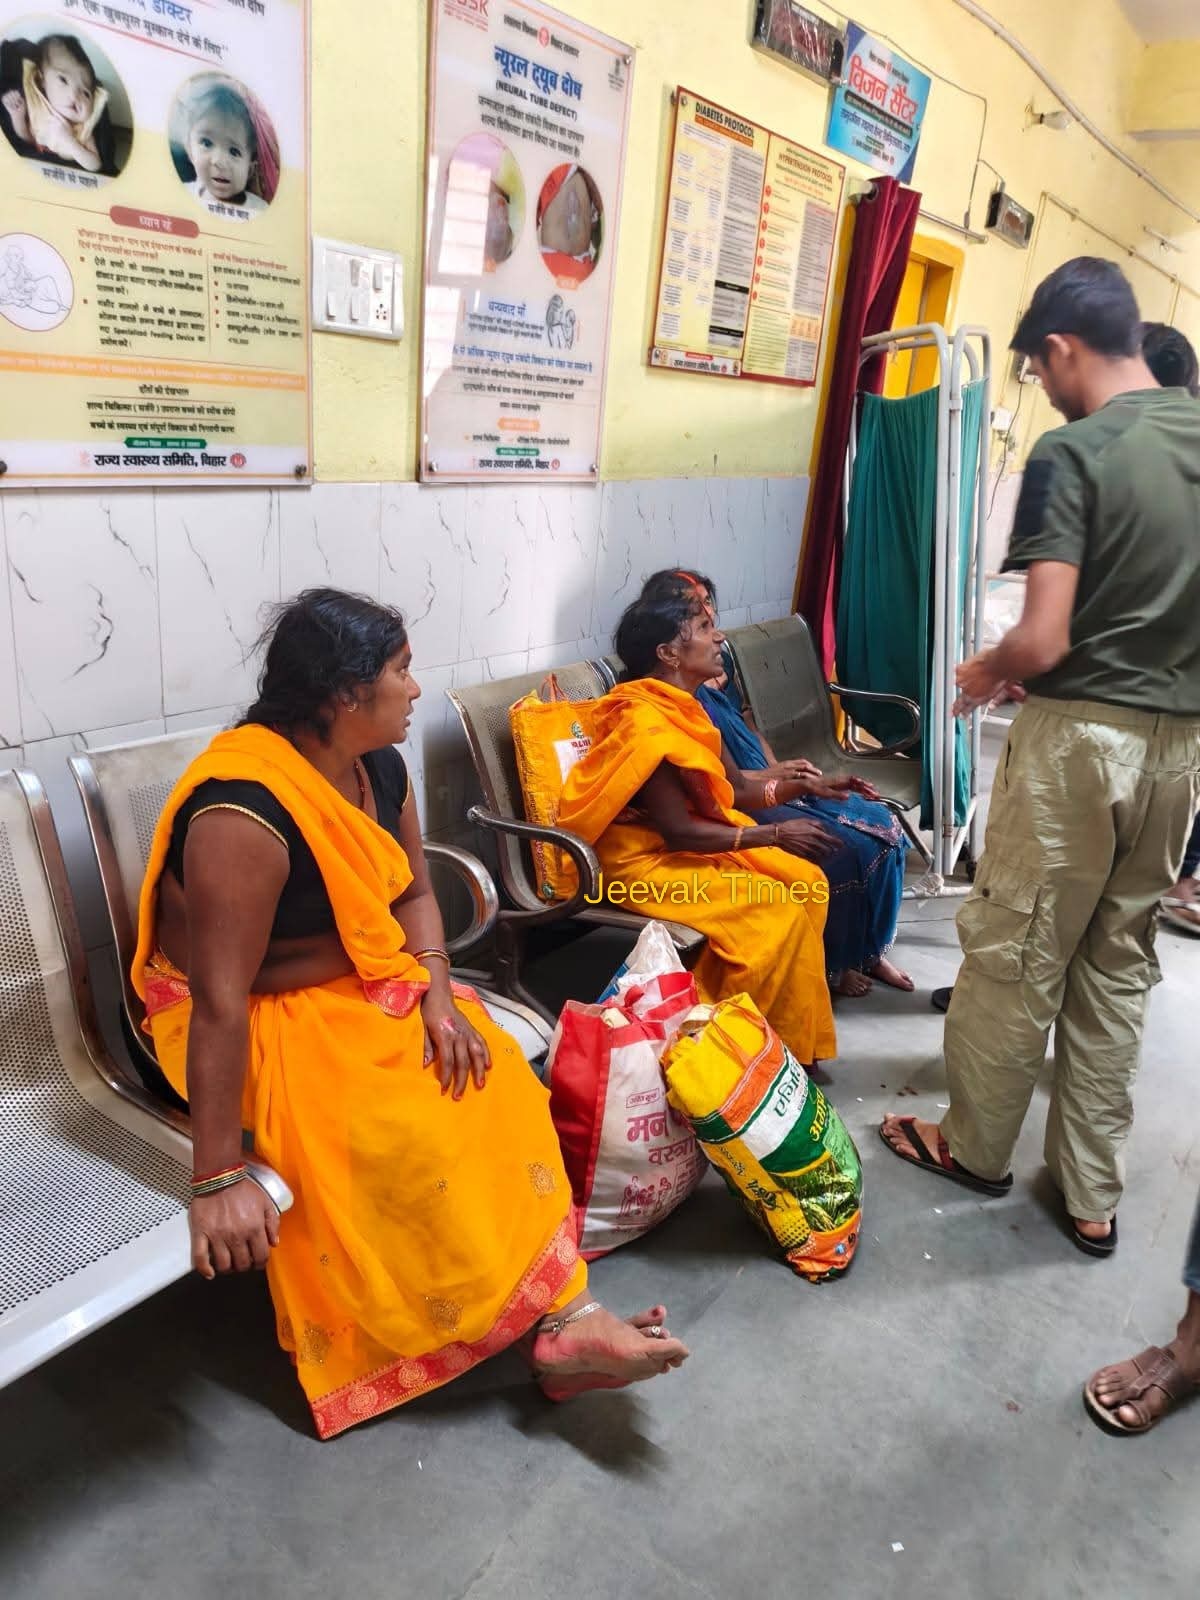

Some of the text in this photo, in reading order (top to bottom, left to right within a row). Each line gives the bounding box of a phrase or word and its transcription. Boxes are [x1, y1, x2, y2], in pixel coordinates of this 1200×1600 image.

[494, 45, 530, 79] न्यूरल
[532, 62, 559, 95] ट्यूब
[561, 71, 583, 100] दोष
[848, 53, 889, 106] विजन
[496, 79, 578, 121] (NEURAL TUBE DEFECT)
[695, 101, 724, 124] DIABETES
[724, 116, 755, 139] PROTOCOL
[94, 452, 227, 468] राज्य स्वास्थ्य समिति, बिहार
[627, 1111, 669, 1142] मन
